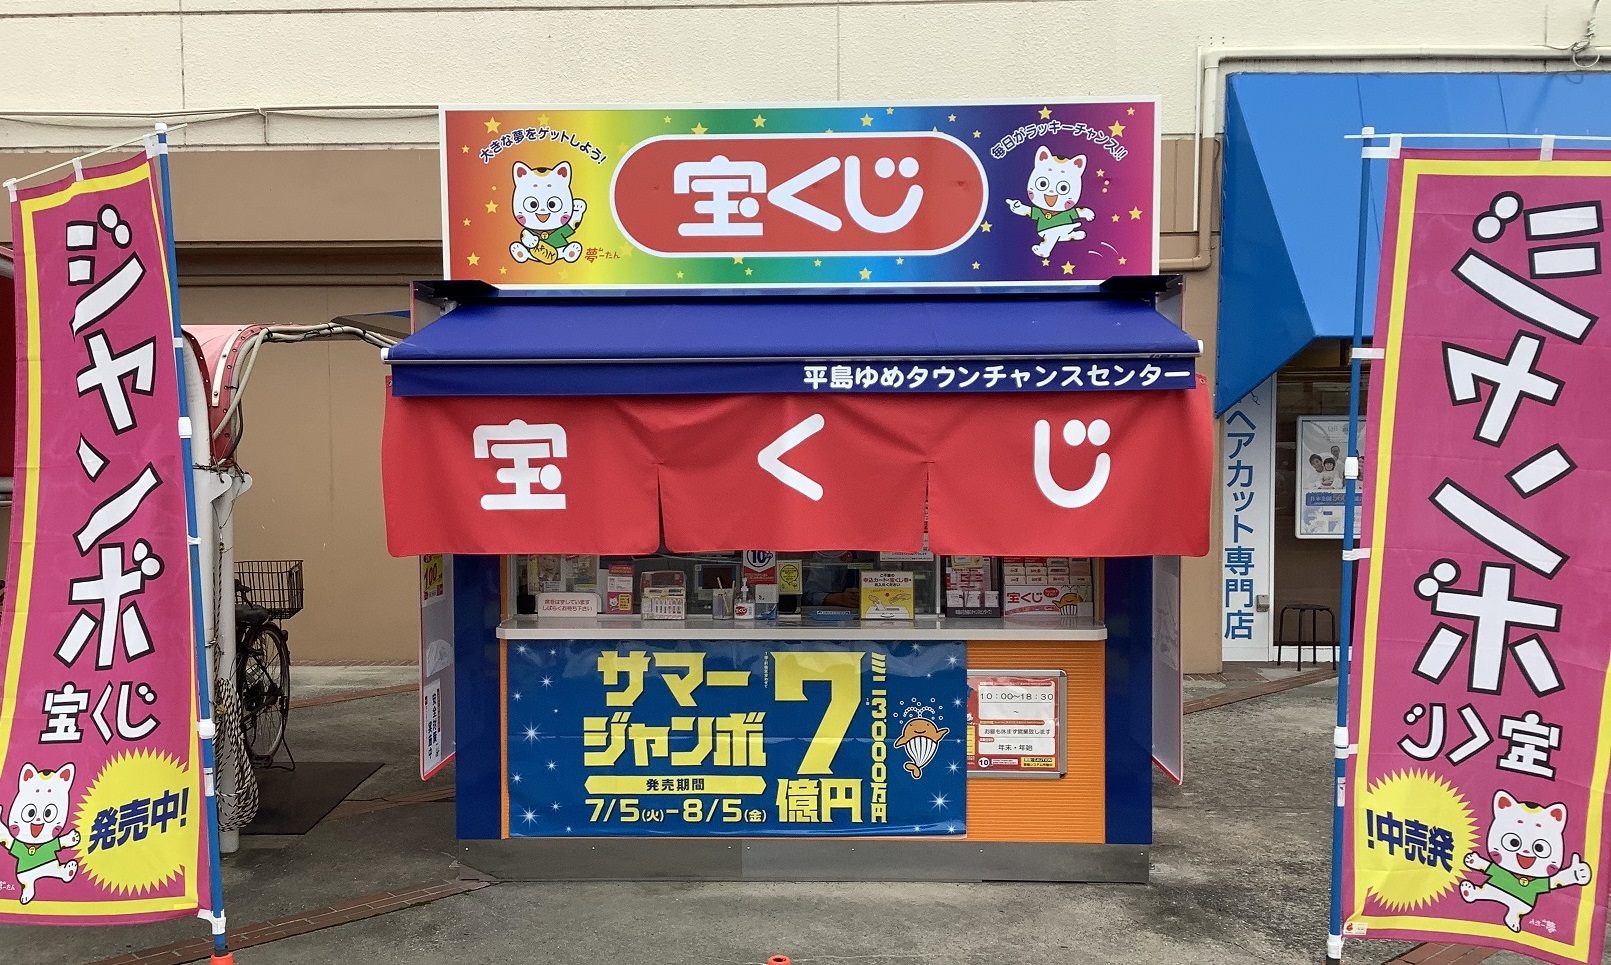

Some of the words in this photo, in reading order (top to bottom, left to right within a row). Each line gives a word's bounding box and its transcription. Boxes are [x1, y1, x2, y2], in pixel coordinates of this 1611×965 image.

[479, 127, 607, 166] 大きな夢をゲットしよう!
[990, 119, 1129, 162] 毎日がラッキーチャンス!!
[673, 155, 924, 237] 宝くじ
[803, 364, 1191, 390] 平島ゆめタウンチャンスセンター
[54, 203, 164, 669] ジャンボ
[1224, 409, 1257, 640] ヘアカット専門店
[1007, 591, 1043, 604] 宝くじ
[597, 650, 751, 707] サマー
[39, 681, 160, 745] 宝くじ
[584, 711, 766, 767] ジャンボ
[998, 744, 1033, 752] 年末・年始
[645, 778, 706, 792] 発売期間
[88, 787, 190, 854] 発売中!
